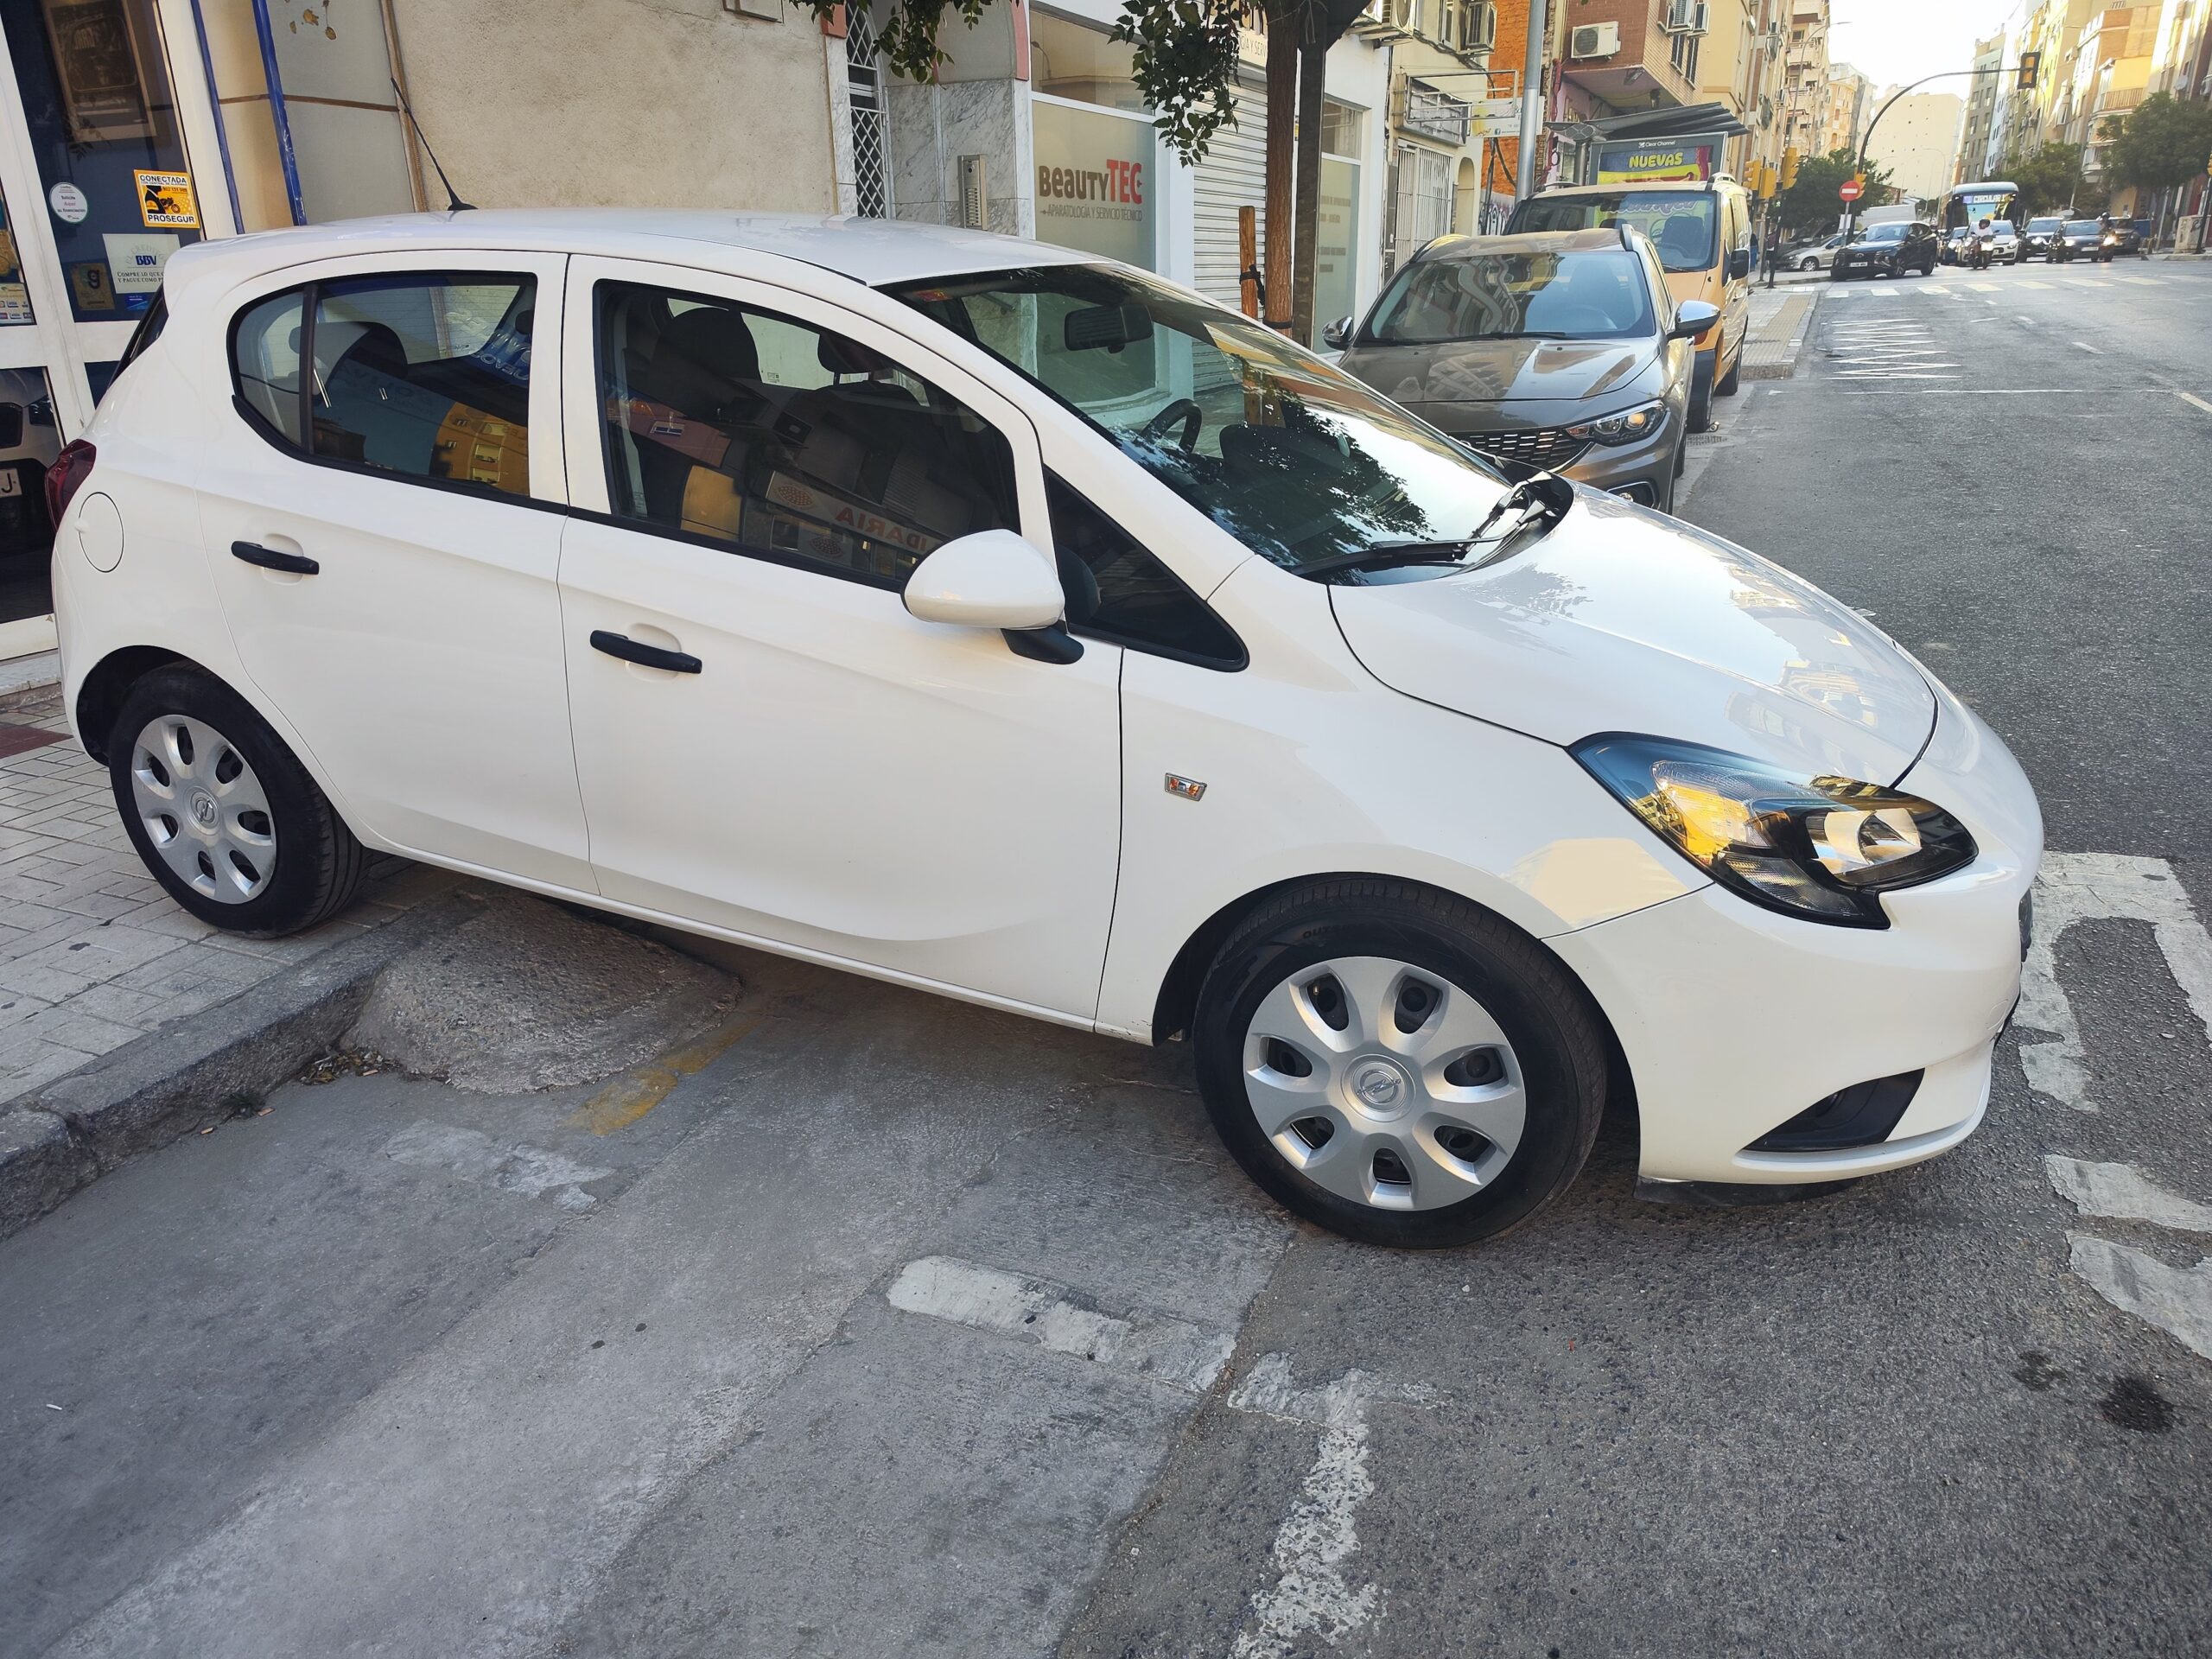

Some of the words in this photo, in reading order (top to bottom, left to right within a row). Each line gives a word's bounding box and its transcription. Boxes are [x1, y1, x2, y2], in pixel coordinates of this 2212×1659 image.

[1629, 151, 1683, 168] NUEVAS
[140, 175, 187, 183] CONECTADA
[1047, 204, 1090, 218] APARATOLOGÍA
[1096, 207, 1121, 220] SERVICIO
[1121, 207, 1142, 221] TÉCNICO
[148, 214, 195, 223] PROSEGUR
[135, 255, 157, 266] BBV
